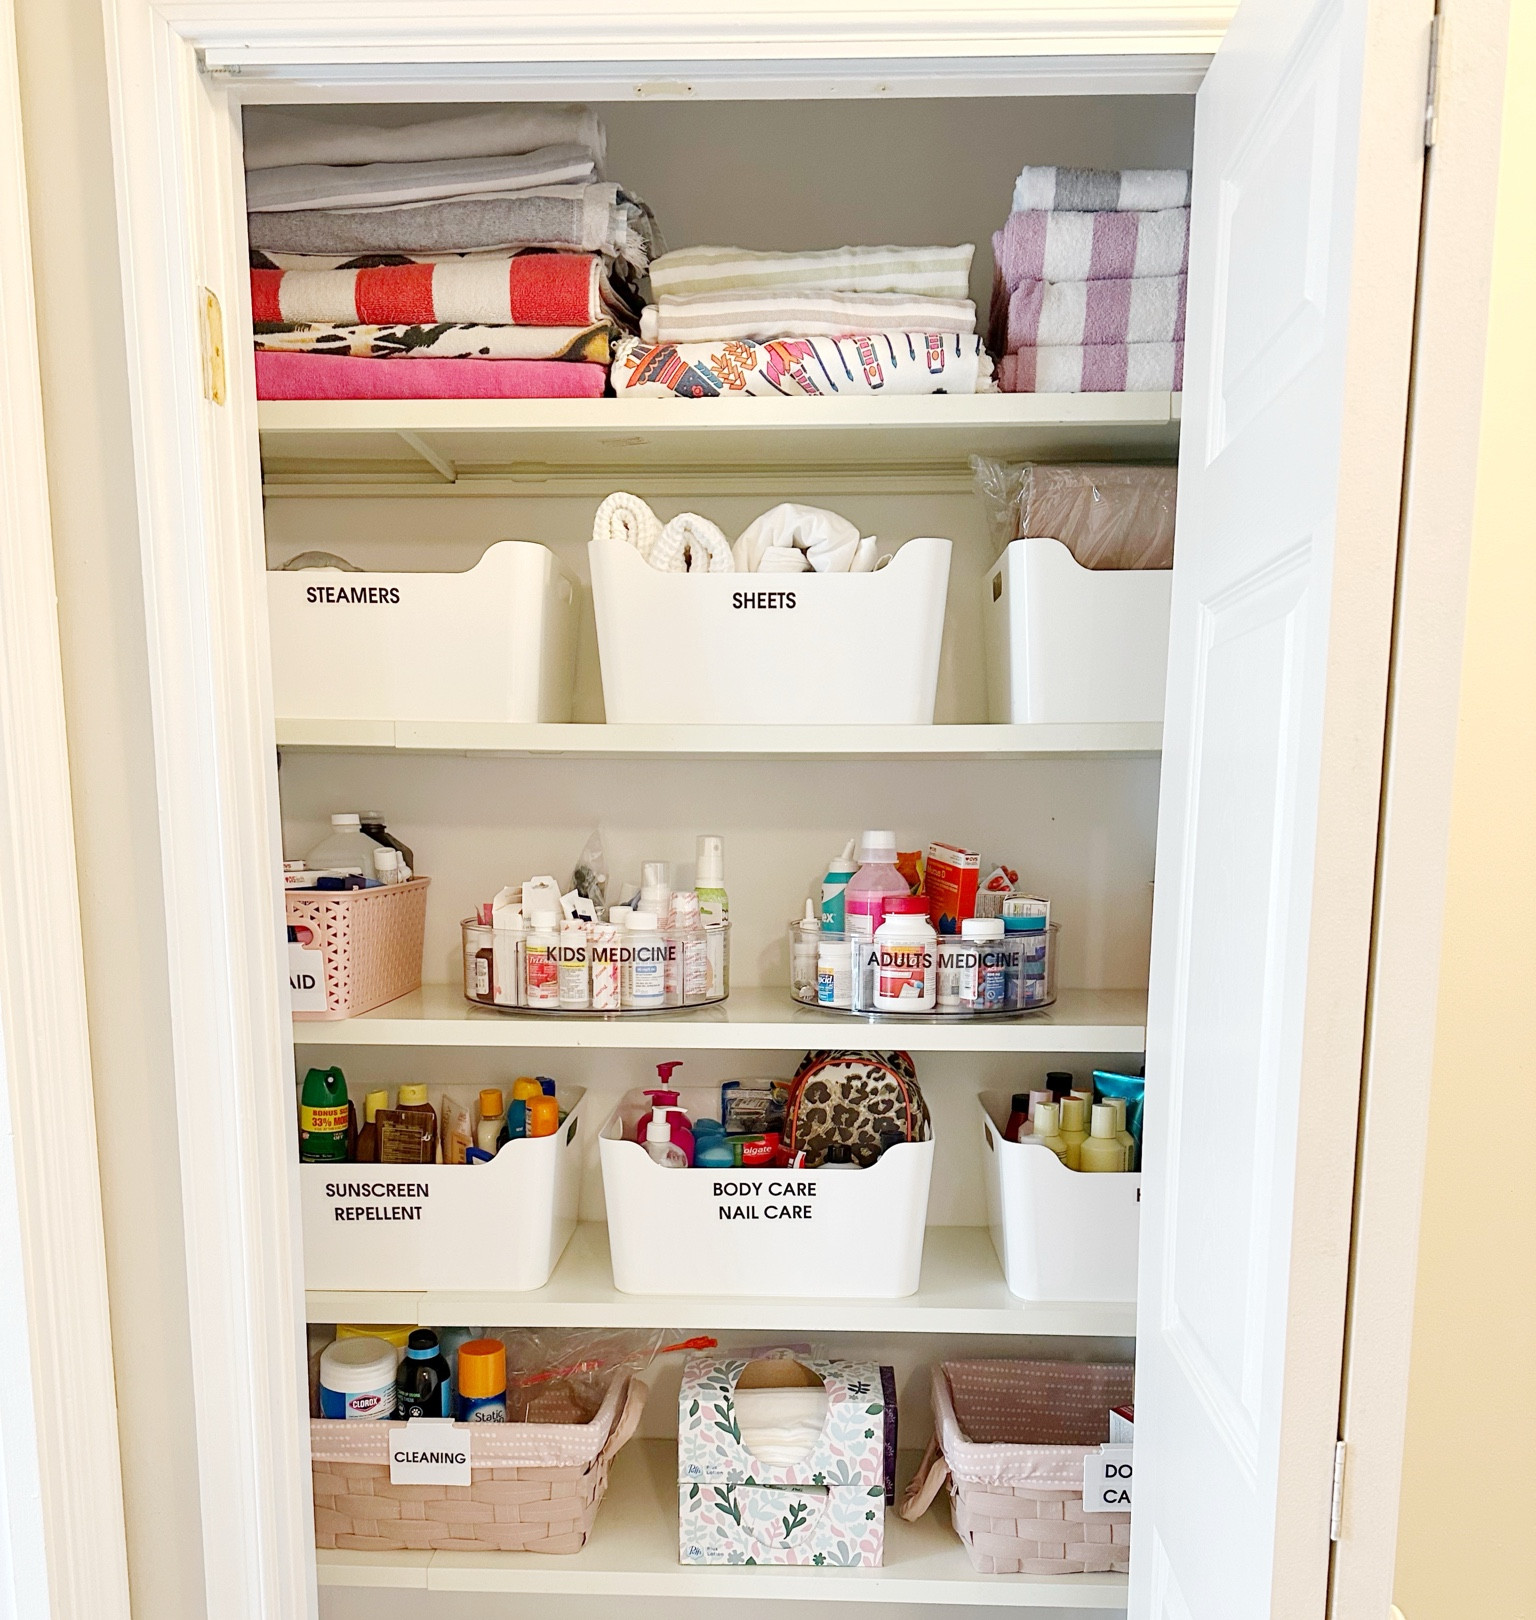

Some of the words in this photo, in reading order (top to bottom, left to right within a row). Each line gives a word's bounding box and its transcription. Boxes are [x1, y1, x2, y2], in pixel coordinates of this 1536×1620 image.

[306, 586, 401, 605] STEAMERS
[732, 592, 797, 609] SHEETS
[546, 946, 586, 963] KIDS
[592, 945, 677, 963] MEDICINE
[867, 951, 932, 969] ADULTS
[938, 951, 1019, 969] MEDICINE
[312, 1109, 338, 1117] BONUS
[312, 1116, 332, 1127] 33%
[743, 1145, 773, 1157] olgate
[325, 1182, 429, 1198] SUNSCREEN
[713, 1182, 763, 1196] BODY
[767, 1182, 817, 1197] CARE
[334, 1205, 423, 1221] REPELLENT
[718, 1205, 760, 1219] NAIL
[763, 1205, 813, 1219] CARE
[352, 1397, 378, 1409] CLOROX
[394, 1450, 467, 1465] CLEANING
